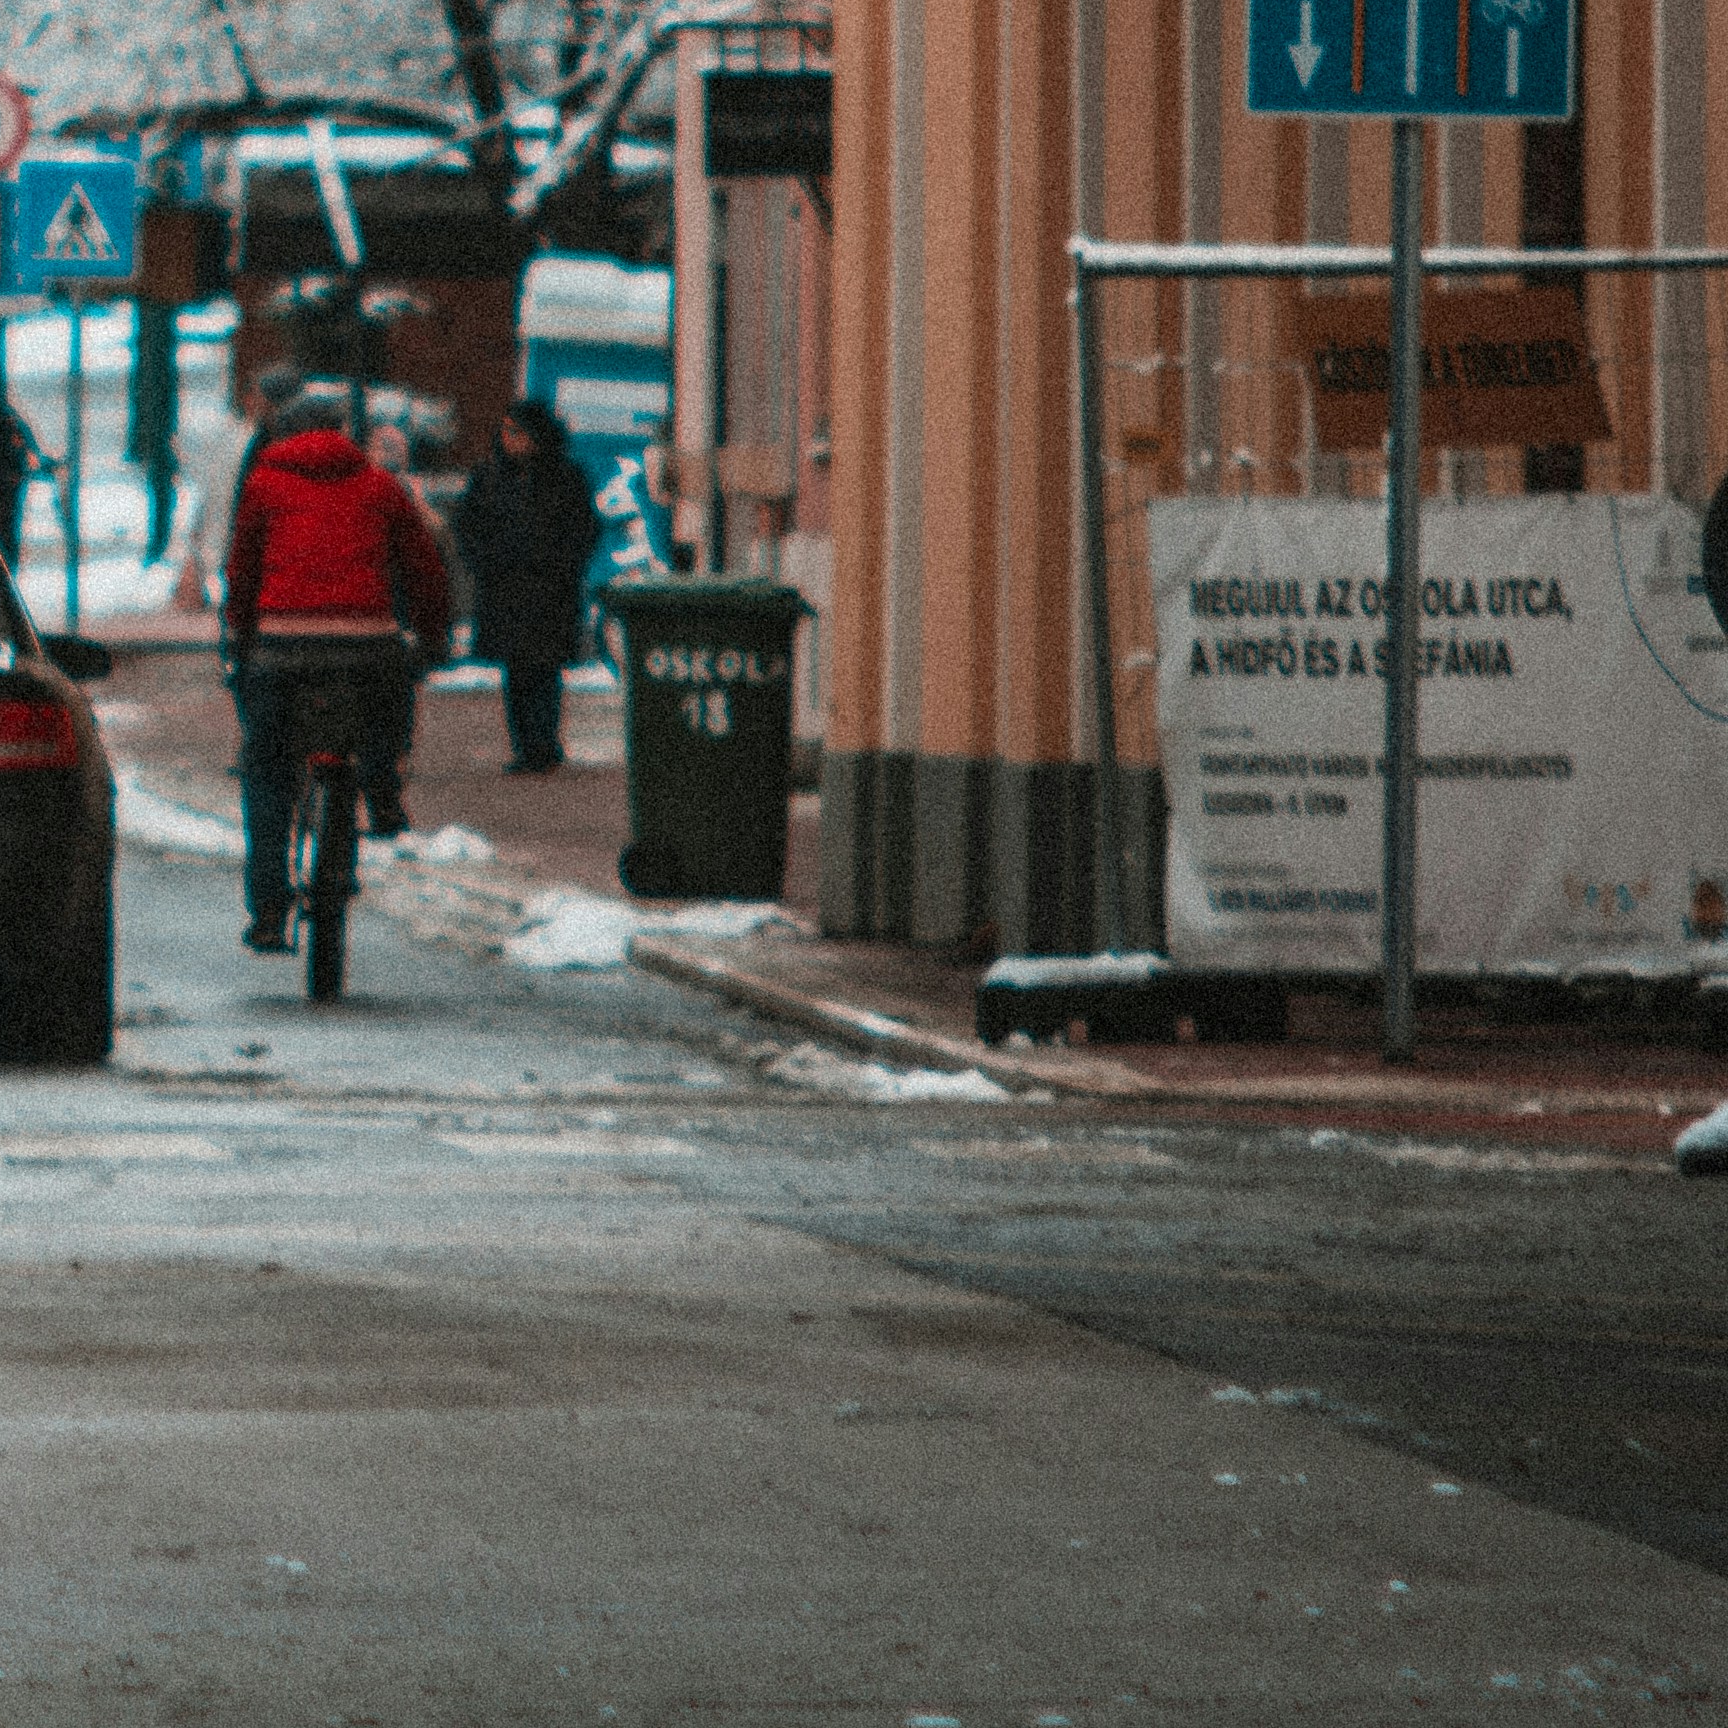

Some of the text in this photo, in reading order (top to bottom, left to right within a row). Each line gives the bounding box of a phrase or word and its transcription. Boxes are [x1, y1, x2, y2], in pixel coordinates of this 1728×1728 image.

[1315, 578, 1353, 618] AZ
[1191, 638, 1212, 677] A
[1302, 626, 1340, 678] ÉS
[1347, 638, 1367, 677] A
[680, 688, 729, 737] 18
